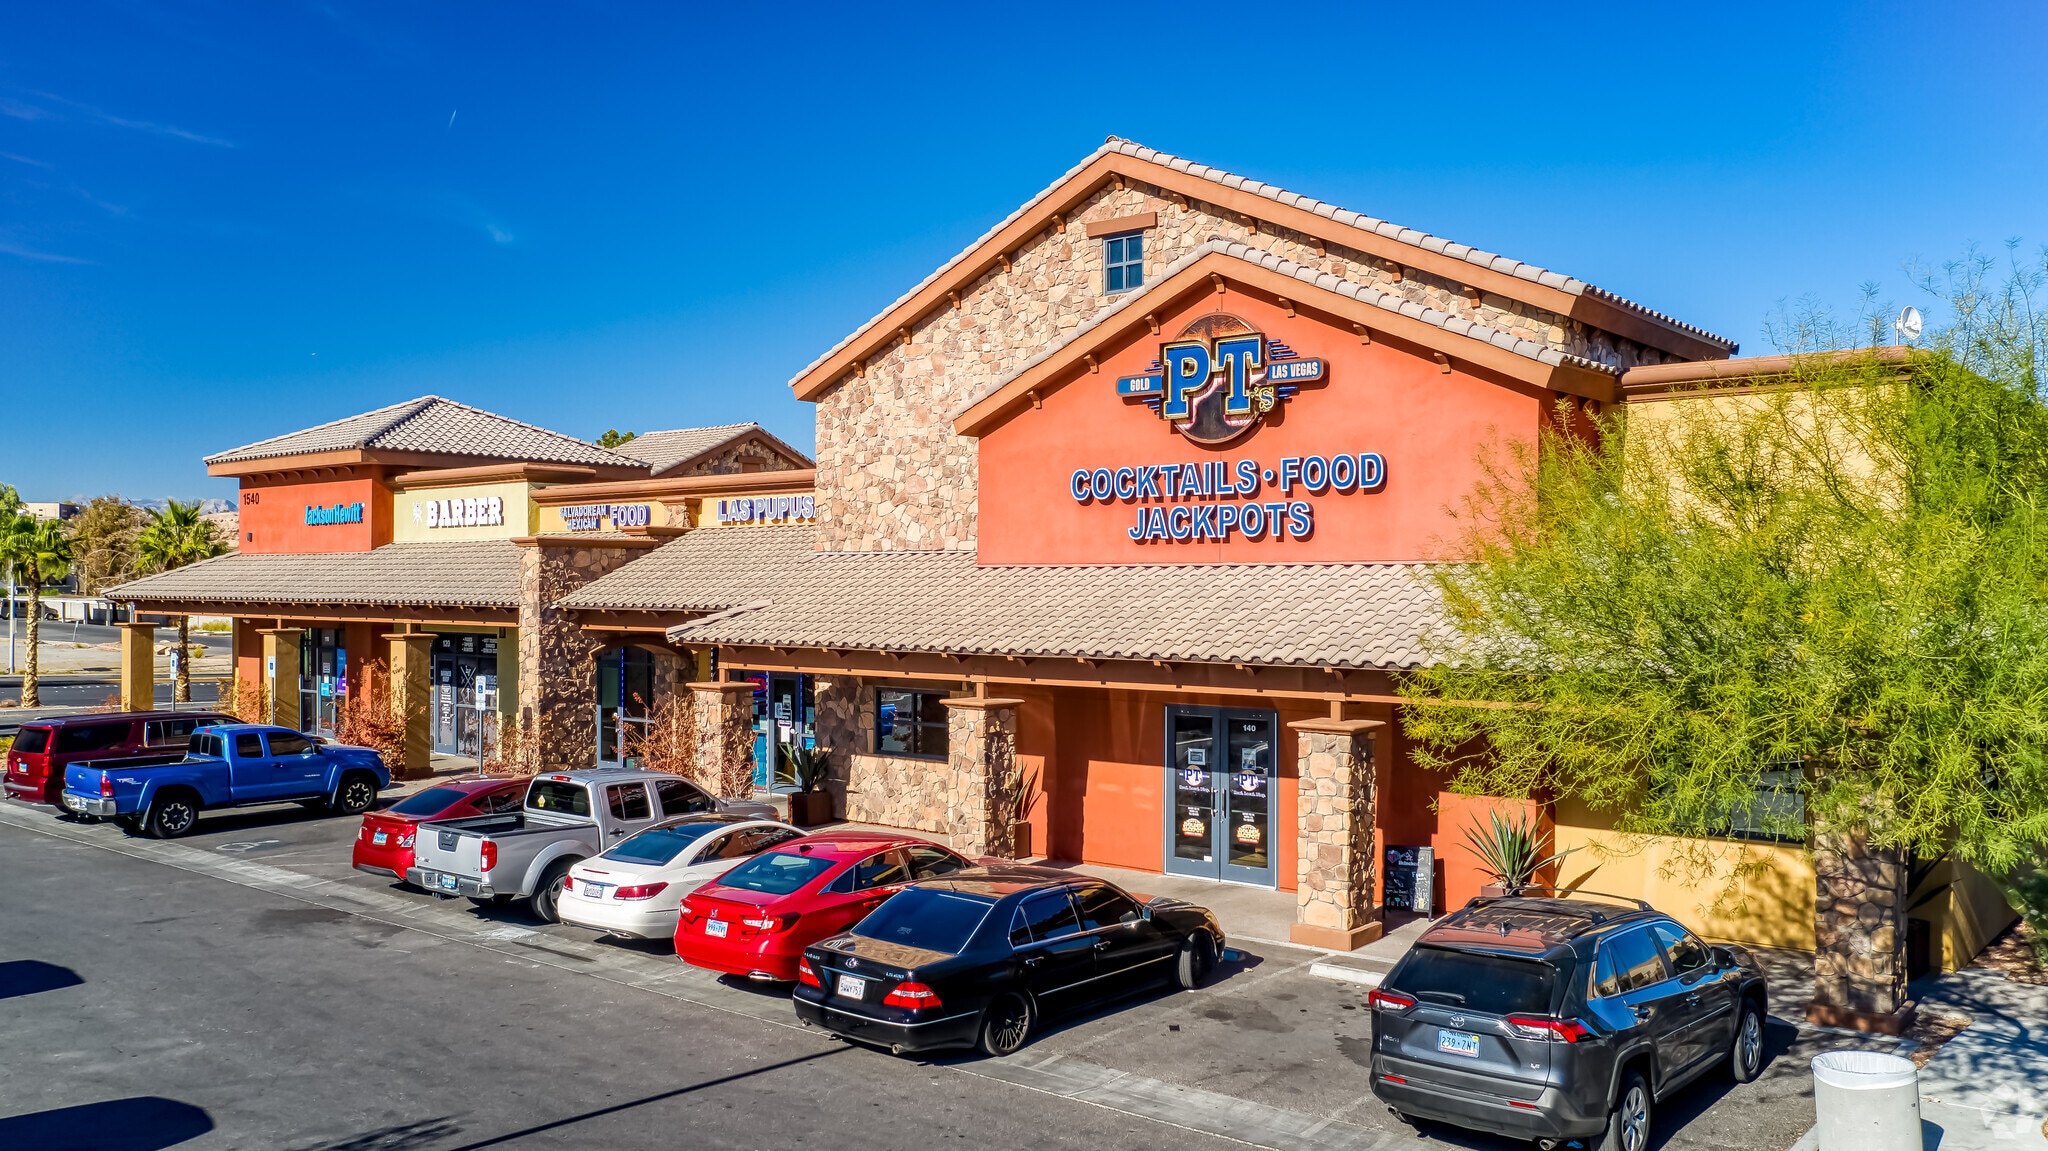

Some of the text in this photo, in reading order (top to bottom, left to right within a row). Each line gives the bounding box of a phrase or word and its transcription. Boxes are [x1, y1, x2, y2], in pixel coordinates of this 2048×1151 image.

[1271, 362, 1318, 379] LAS VEGAS
[1129, 377, 1151, 392] GOLD
[1070, 452, 1384, 501] COCKTAILS FOOD
[243, 492, 260, 505] 1540
[717, 495, 816, 522] LAS PUPUS
[427, 497, 503, 526] BARBER
[610, 504, 647, 527] FOOD
[1128, 502, 1312, 540] JACKPOTS
[567, 518, 598, 530] MEXICAN
[1242, 724, 1257, 732] 140
